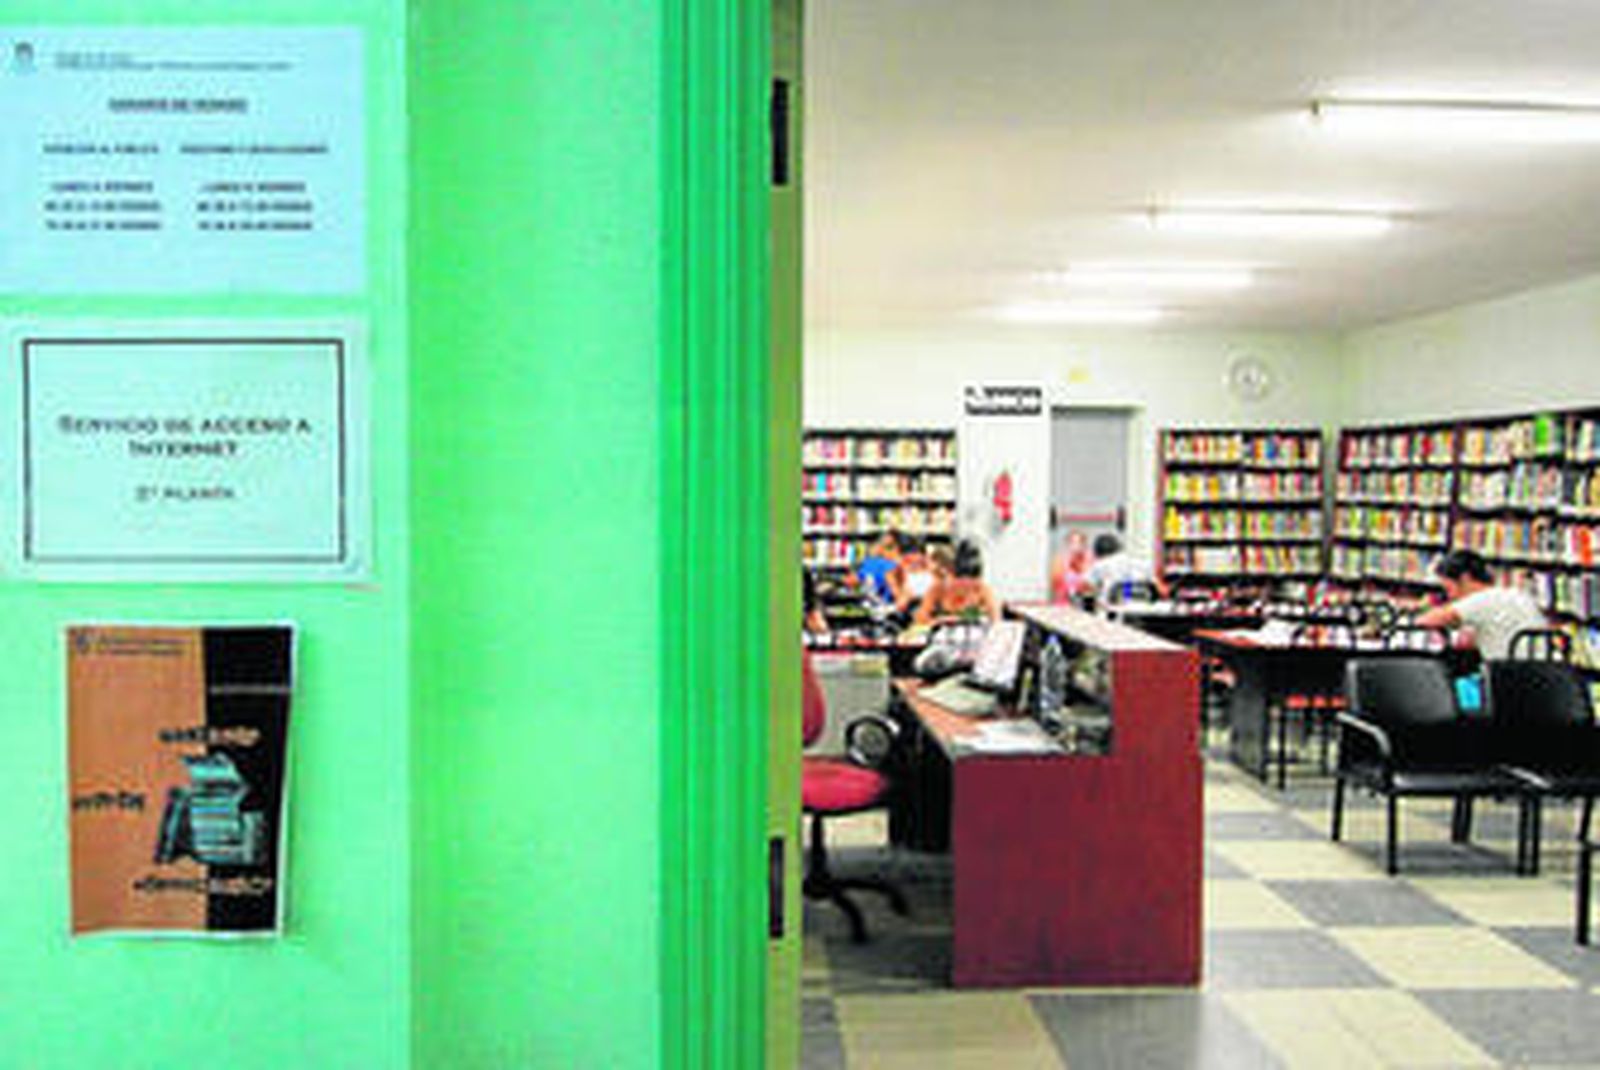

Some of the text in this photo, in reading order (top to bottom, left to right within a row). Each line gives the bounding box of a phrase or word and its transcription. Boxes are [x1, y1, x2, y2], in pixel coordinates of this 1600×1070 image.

[58, 415, 158, 434] SERVICIO
[200, 417, 291, 434] ACCESO
[296, 417, 311, 433] A
[129, 440, 237, 456] INTERNET
